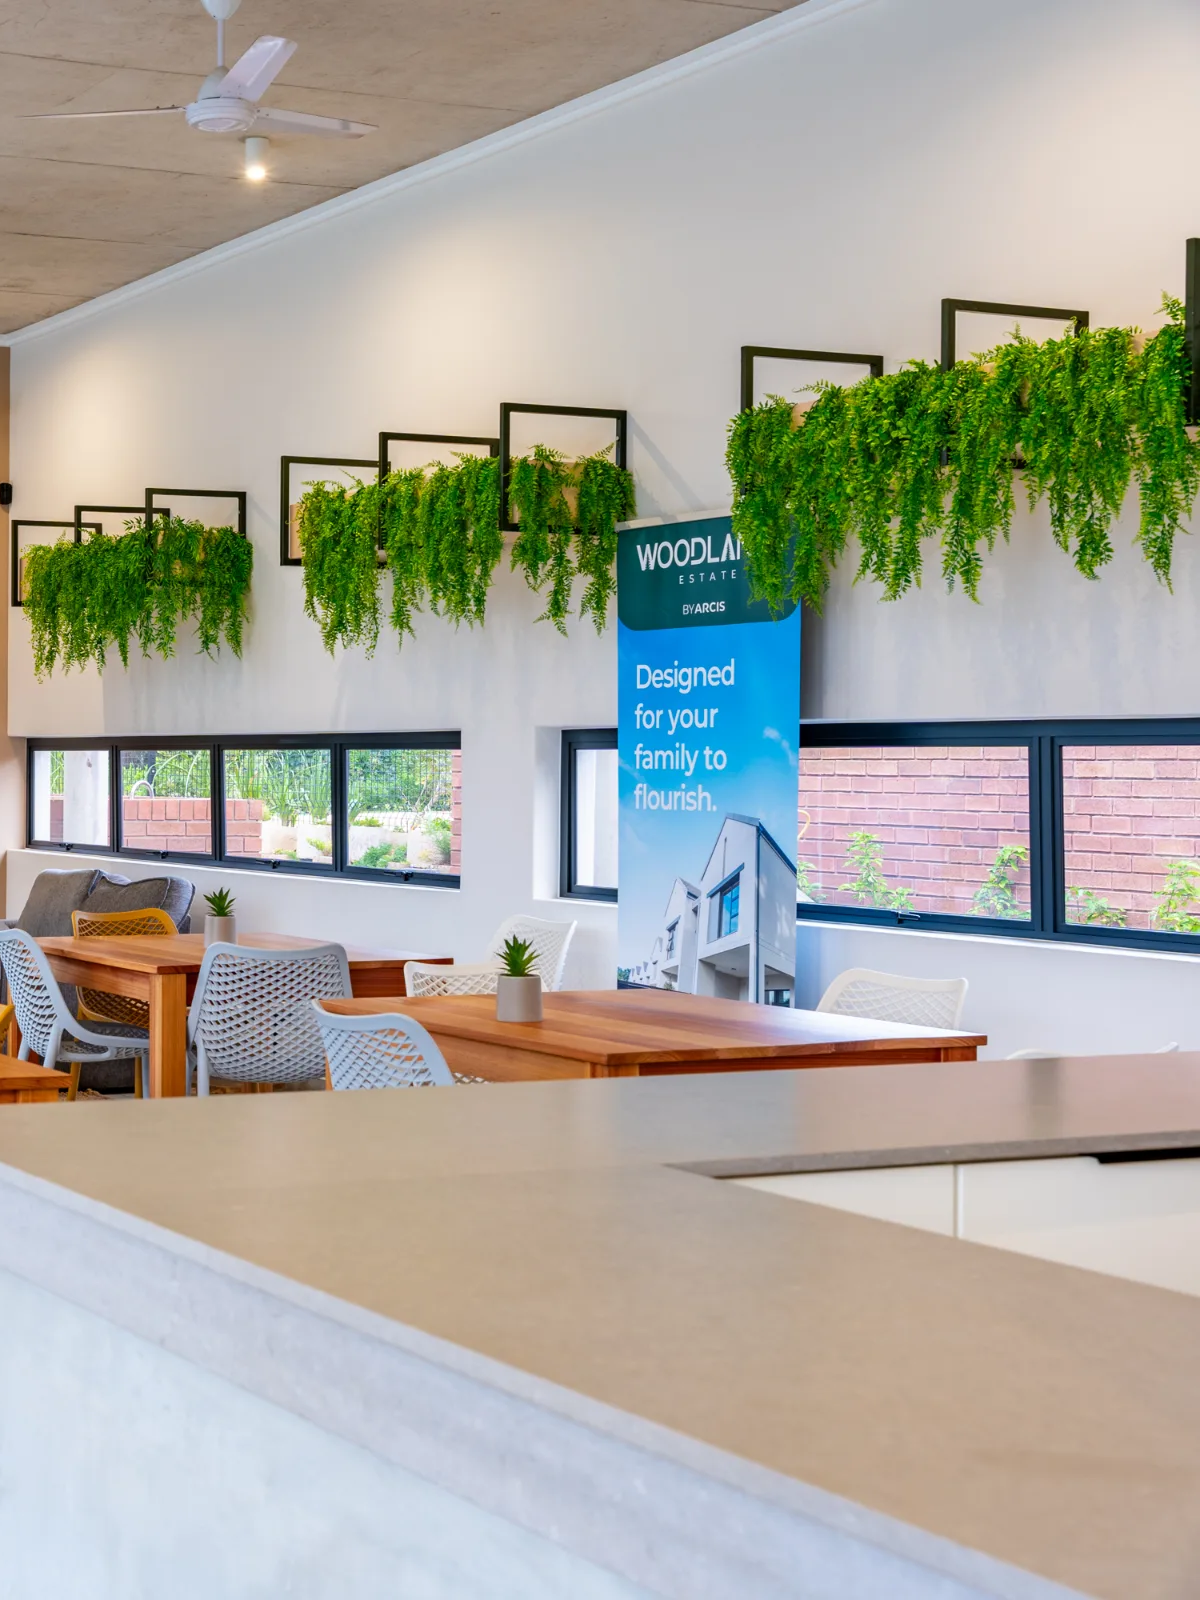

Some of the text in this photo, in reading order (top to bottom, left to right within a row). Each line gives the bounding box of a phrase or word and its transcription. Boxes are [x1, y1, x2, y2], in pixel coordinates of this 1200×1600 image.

[636, 533, 743, 571] WOODLA
[679, 569, 737, 585] ESTATE
[636, 658, 735, 694] Designed
[634, 703, 719, 735] for your
[634, 742, 728, 777] family to
[634, 783, 717, 812] flourish.
